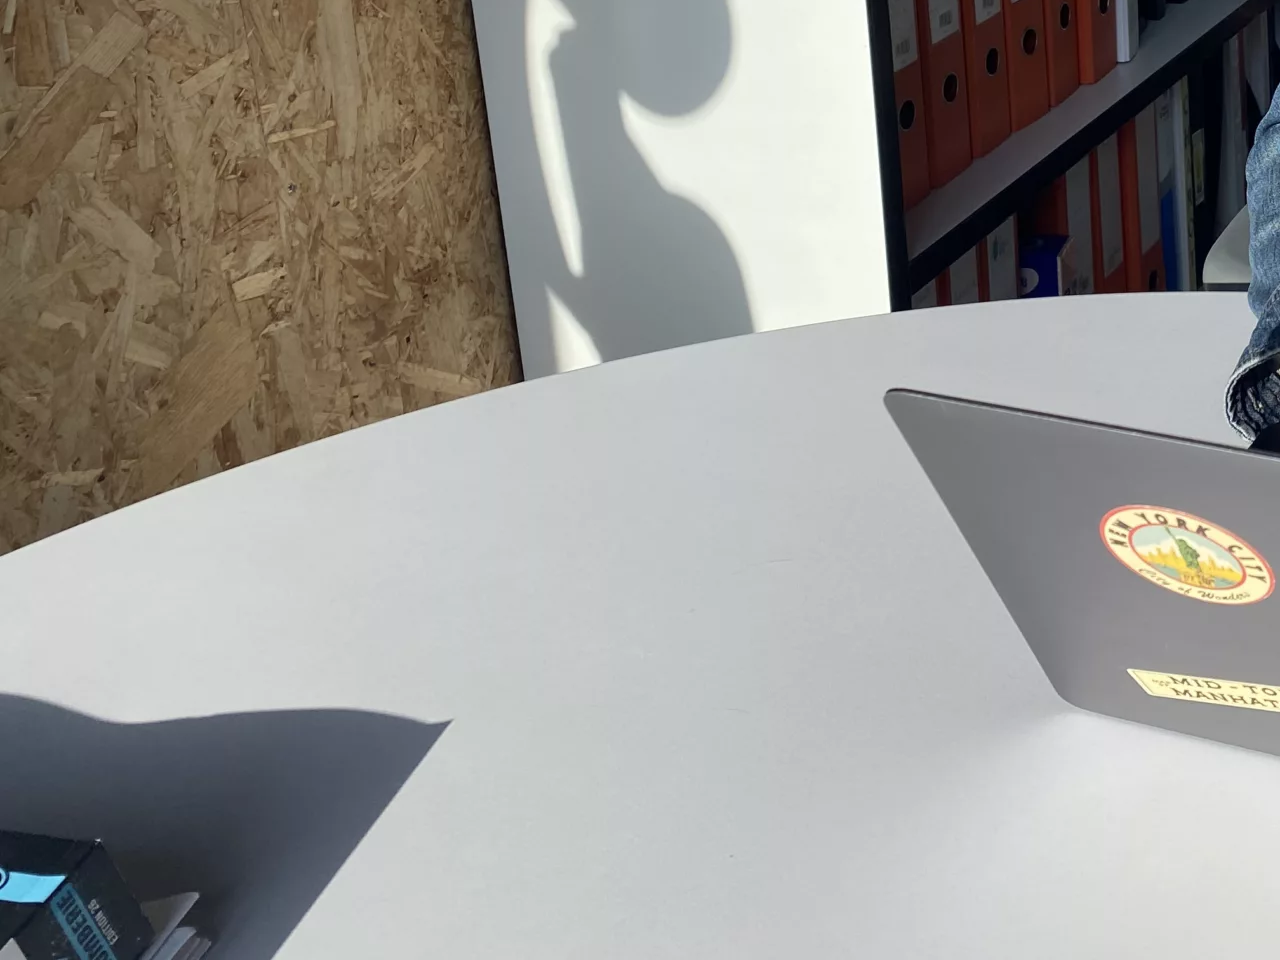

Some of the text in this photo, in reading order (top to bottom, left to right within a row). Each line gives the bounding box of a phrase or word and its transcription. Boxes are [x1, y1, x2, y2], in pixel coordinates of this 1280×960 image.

[1109, 512, 1267, 584] NEW YORK CITY
[94, 910, 119, 946] EDITION
